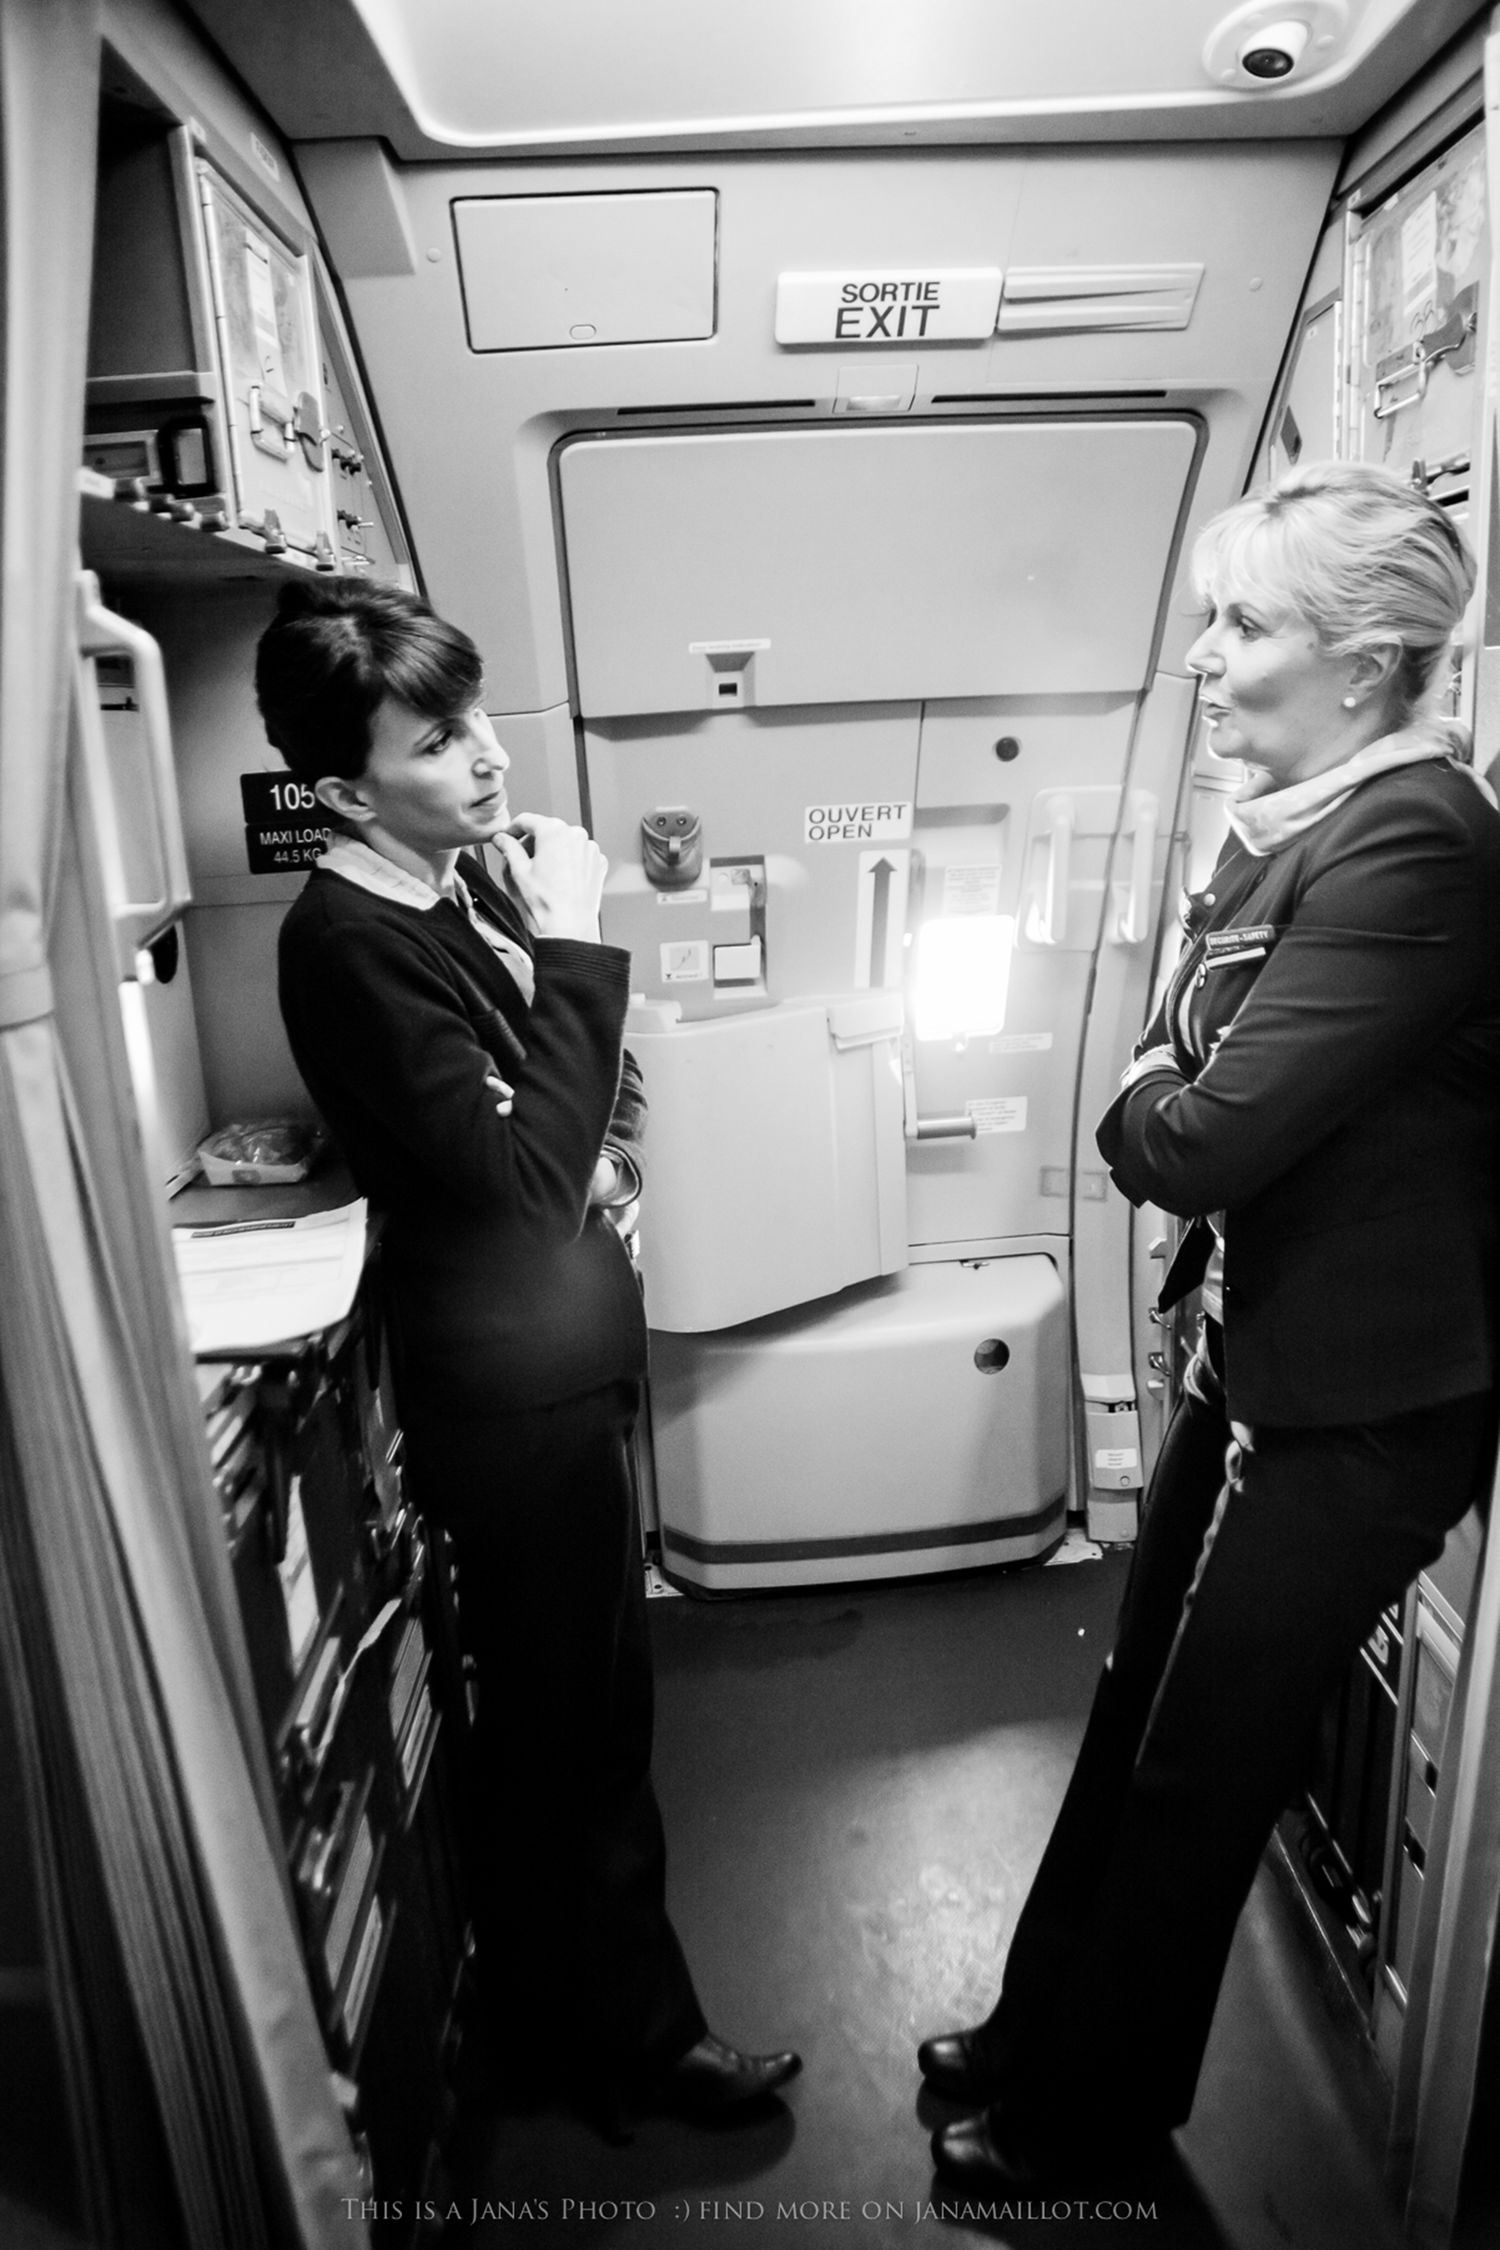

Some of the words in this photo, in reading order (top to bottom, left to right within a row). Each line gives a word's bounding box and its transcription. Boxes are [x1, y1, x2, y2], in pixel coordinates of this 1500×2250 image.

[841, 282, 940, 303] SORTIE
[835, 305, 940, 338] EXIT
[270, 783, 315, 810] 105
[808, 804, 907, 825] OUVERT
[259, 830, 293, 845] MAXI
[808, 823, 873, 841] OPEN
[273, 849, 301, 864] 44.5
